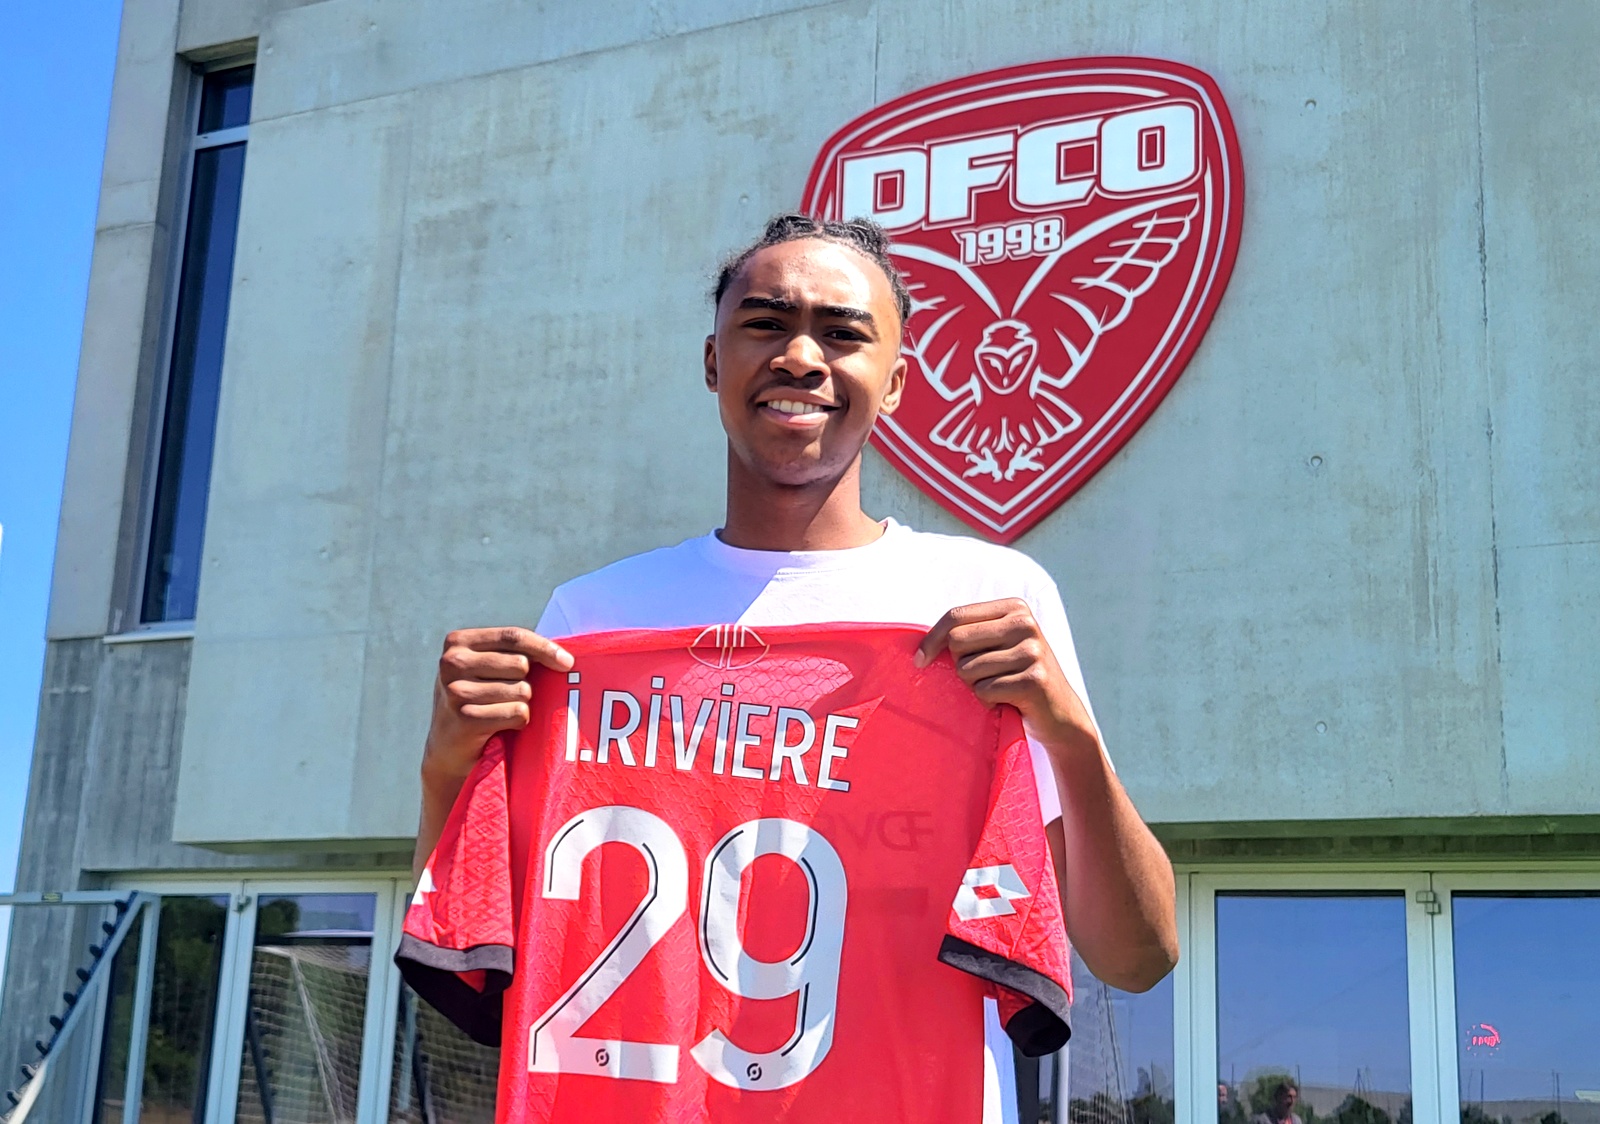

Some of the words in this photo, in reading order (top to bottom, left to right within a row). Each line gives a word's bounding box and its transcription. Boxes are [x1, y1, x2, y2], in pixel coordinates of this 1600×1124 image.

[838, 100, 1201, 232] DFCO
[954, 216, 1064, 266] 1998
[528, 804, 848, 1092] 29
